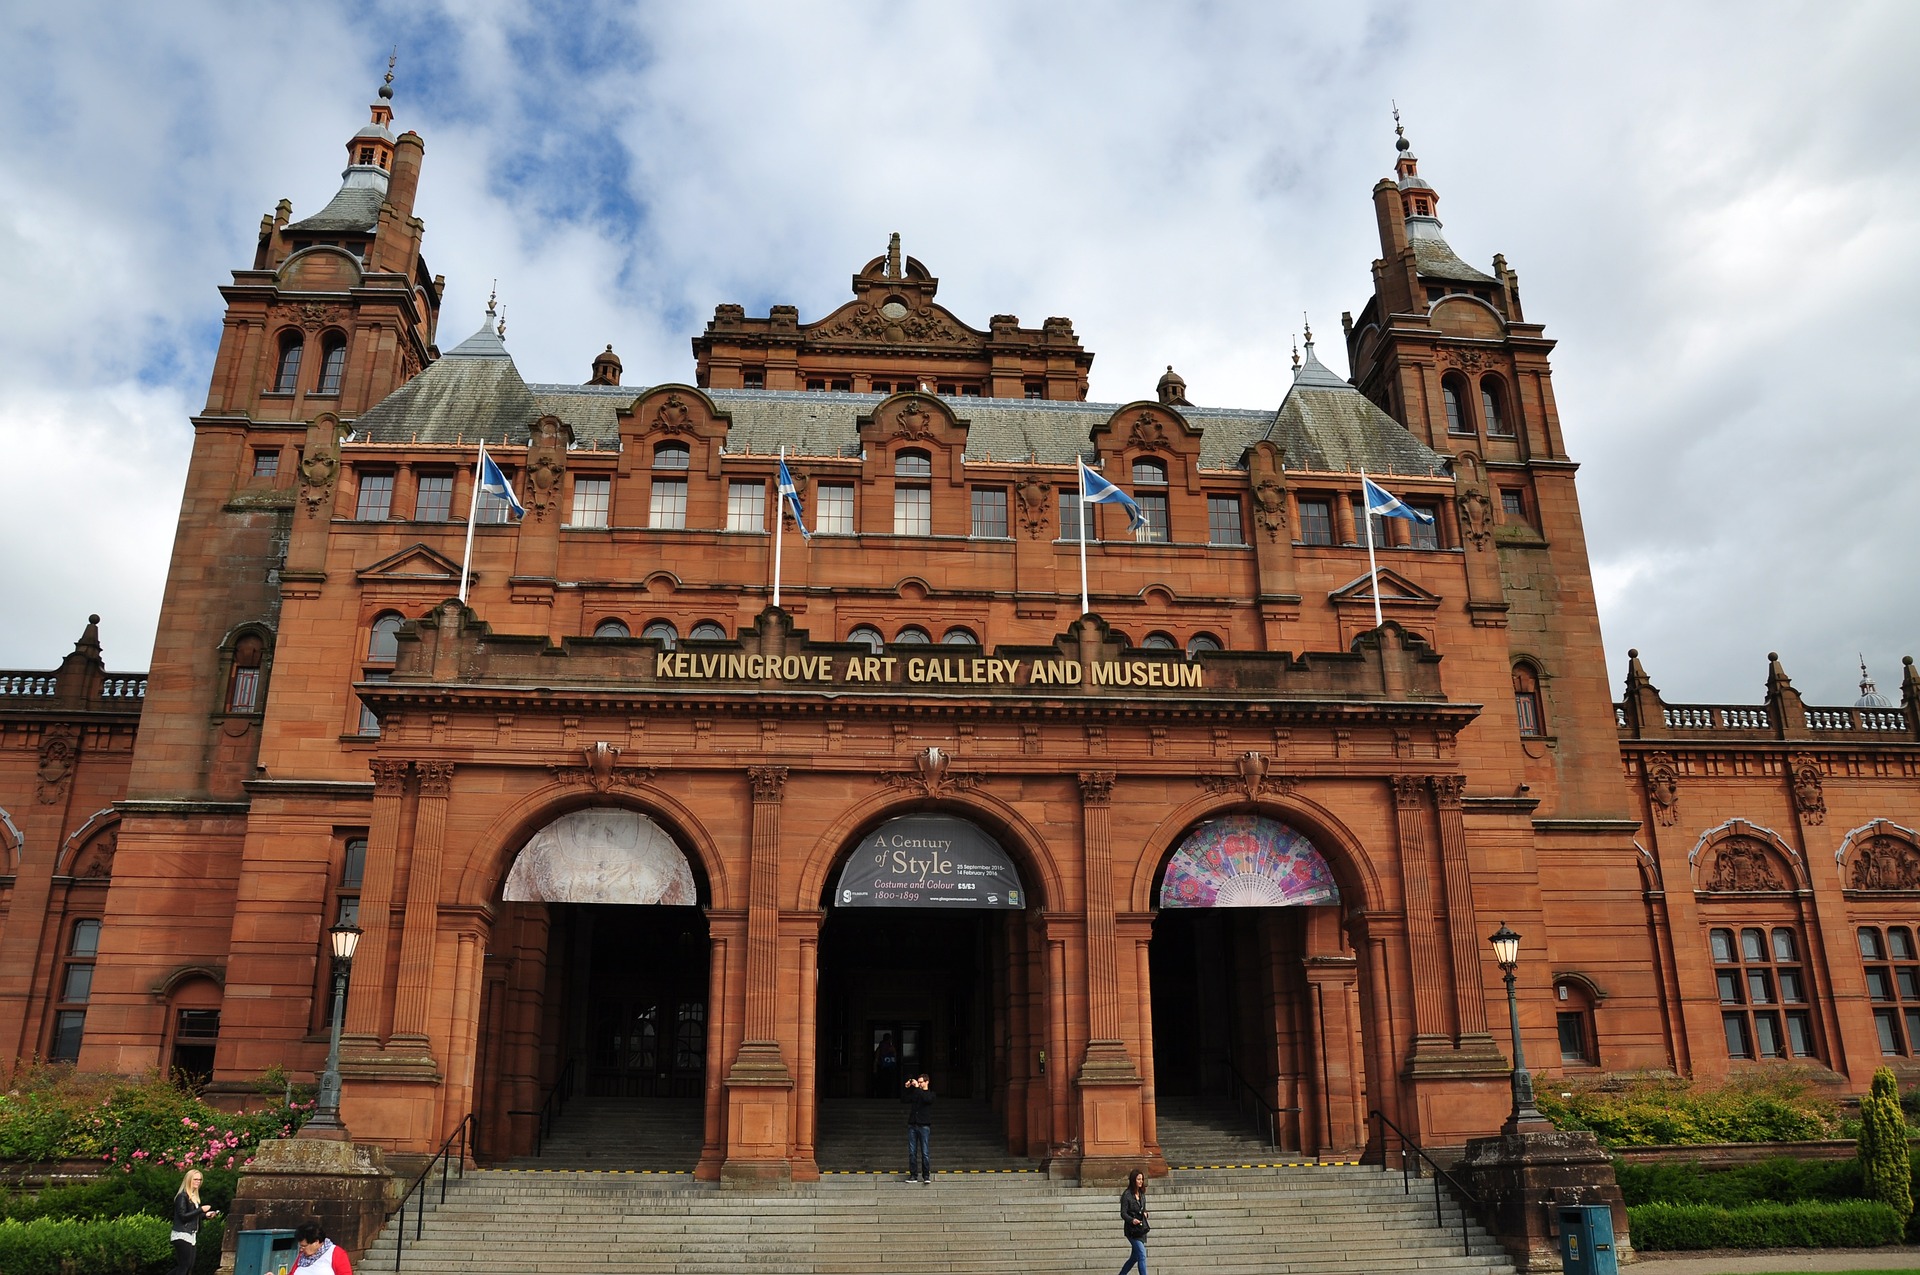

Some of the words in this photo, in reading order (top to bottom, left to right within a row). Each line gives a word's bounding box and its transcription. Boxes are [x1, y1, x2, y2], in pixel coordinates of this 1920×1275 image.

[655, 652, 833, 681] KELVINGROVE
[845, 656, 897, 682] ART
[908, 657, 1020, 684] GALLERY
[1029, 660, 1082, 685] AND
[1090, 660, 1203, 688] MUSEUM
[874, 835, 887, 847] A
[891, 834, 952, 853] Century
[874, 850, 890, 867] of
[891, 850, 953, 882] Style
[874, 879, 909, 889] Costume
[909, 880, 925, 889] and
[926, 880, 955, 890] Colour
[874, 891, 920, 902] 1800-1899
